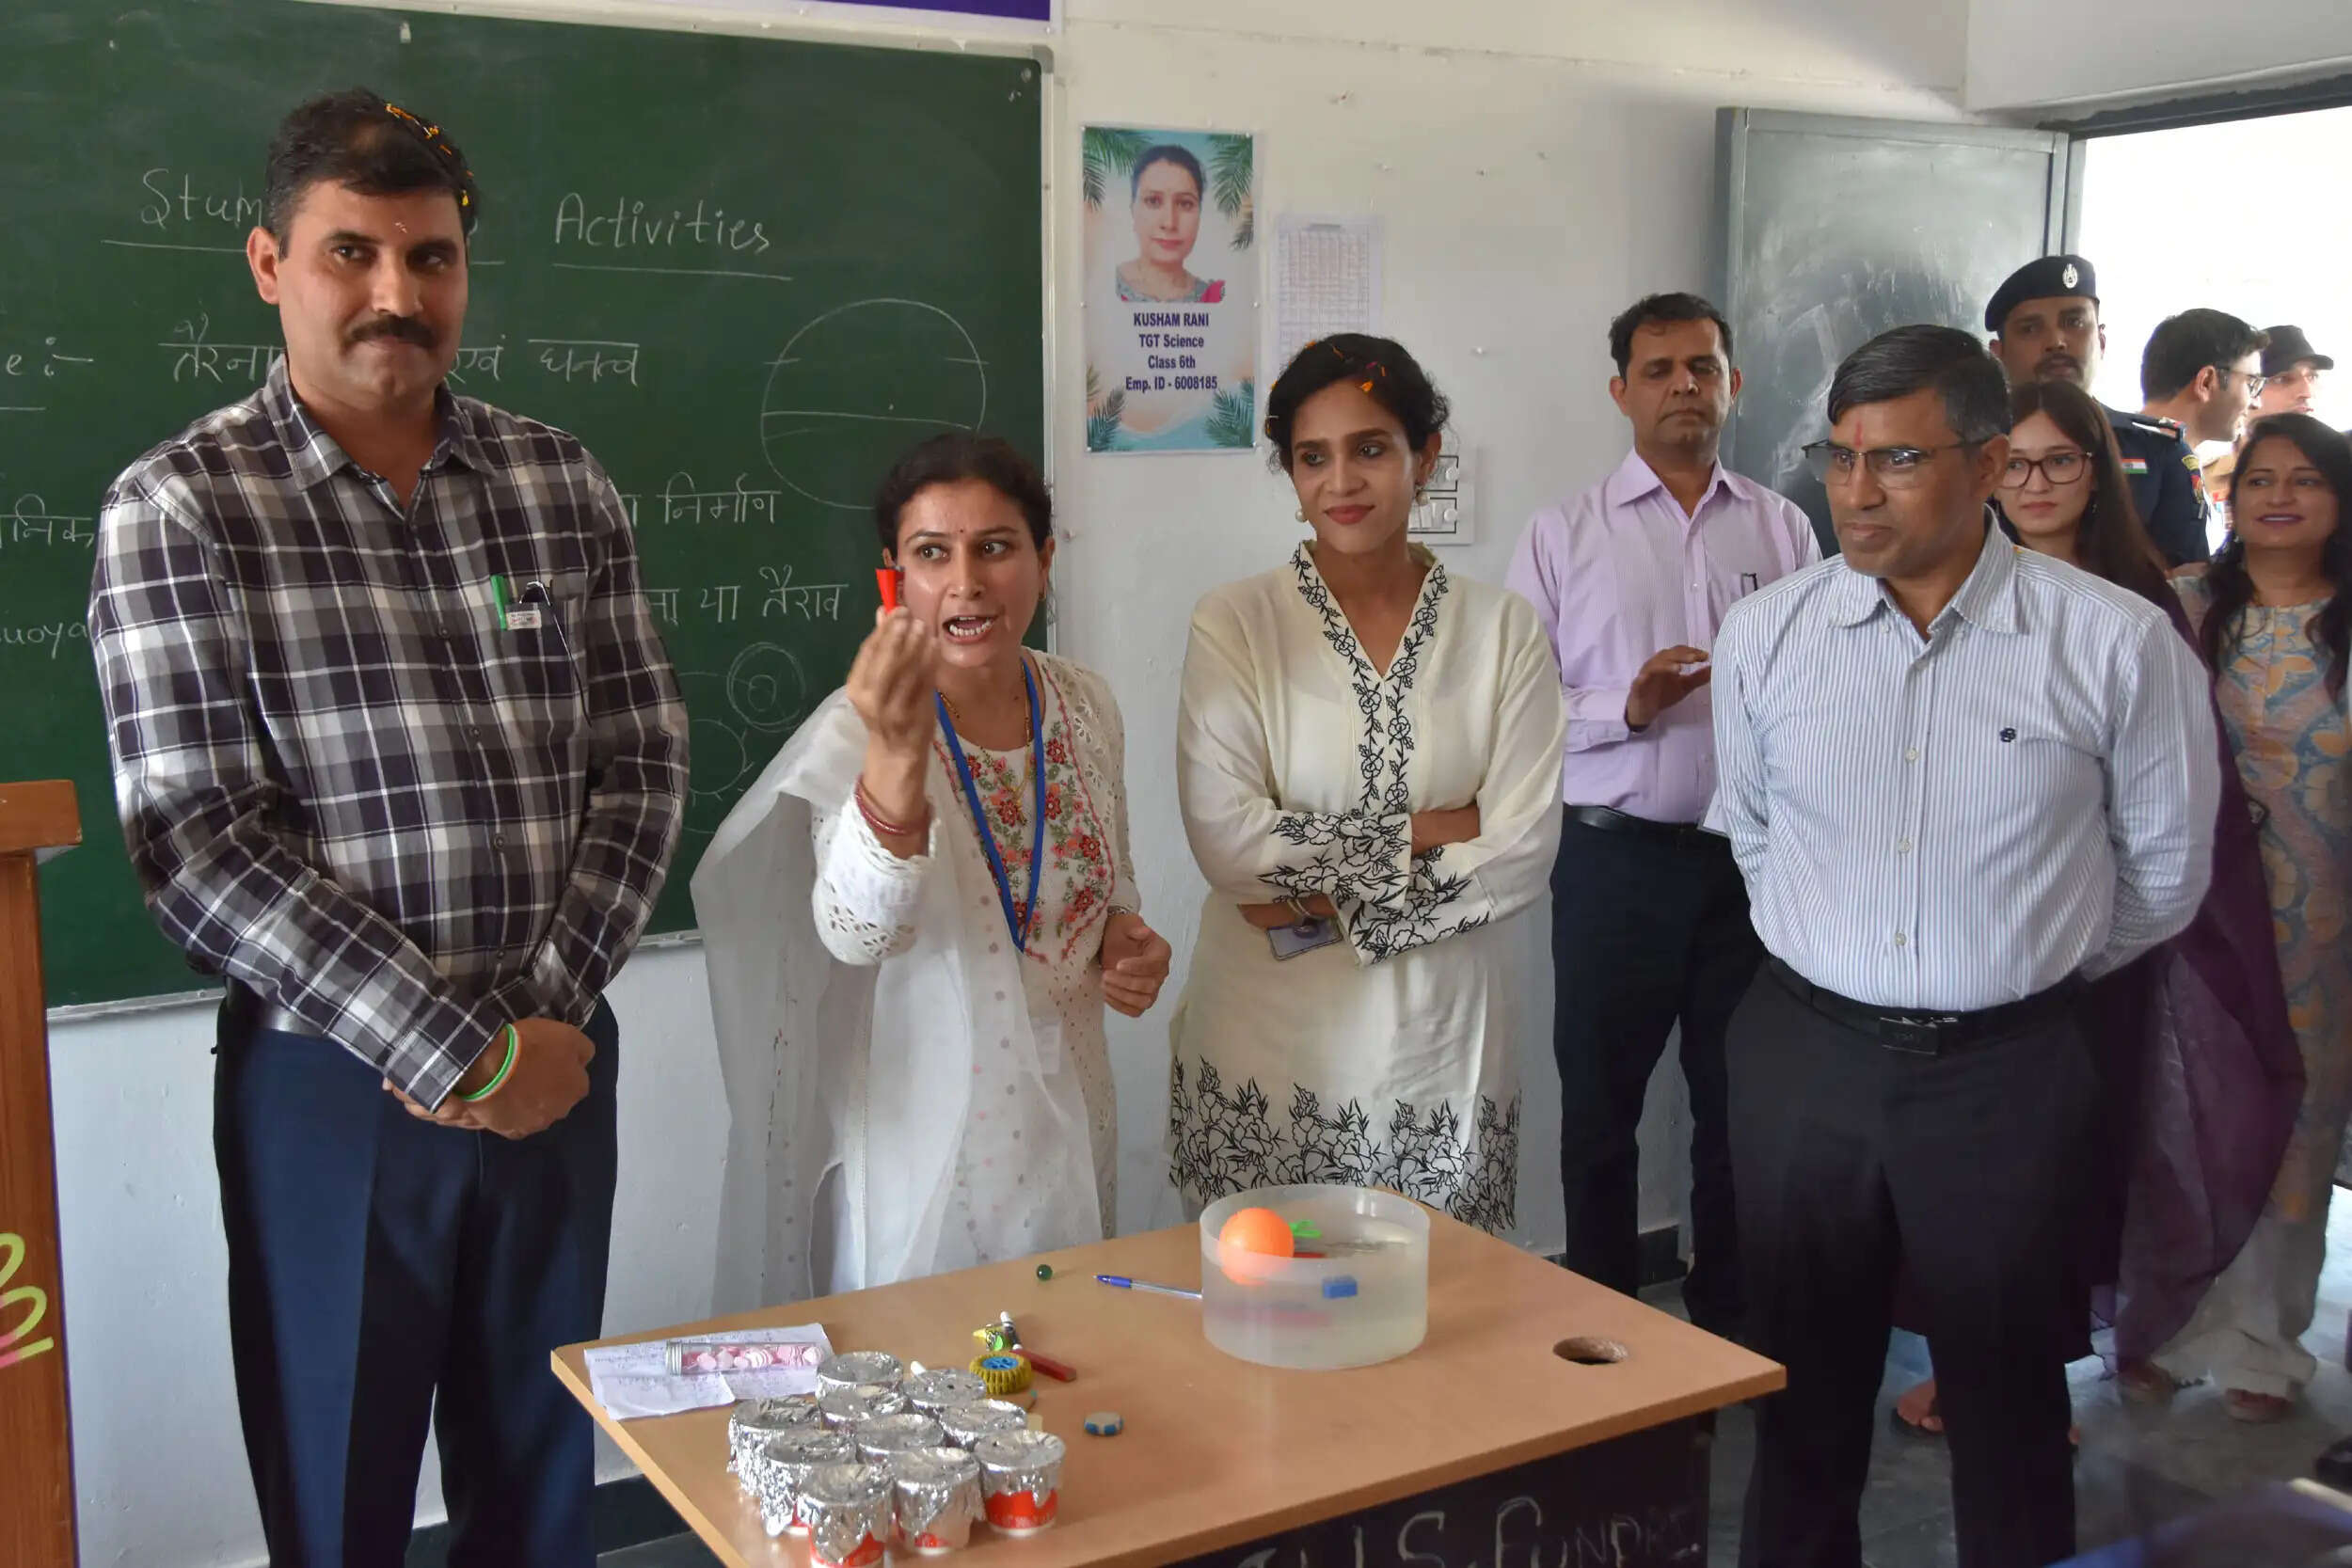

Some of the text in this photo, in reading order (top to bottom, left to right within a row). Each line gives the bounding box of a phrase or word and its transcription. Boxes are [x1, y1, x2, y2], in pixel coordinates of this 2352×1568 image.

[141, 167, 770, 254] Stum Activities
[1133, 312, 1209, 326] KUSHAM RANI
[1139, 334, 1204, 348] TGT Science
[1148, 355, 1196, 369] Class 6th
[1125, 376, 1151, 393] Emp.
[1154, 376, 1165, 390] ID
[1174, 376, 1217, 390] 6008185
